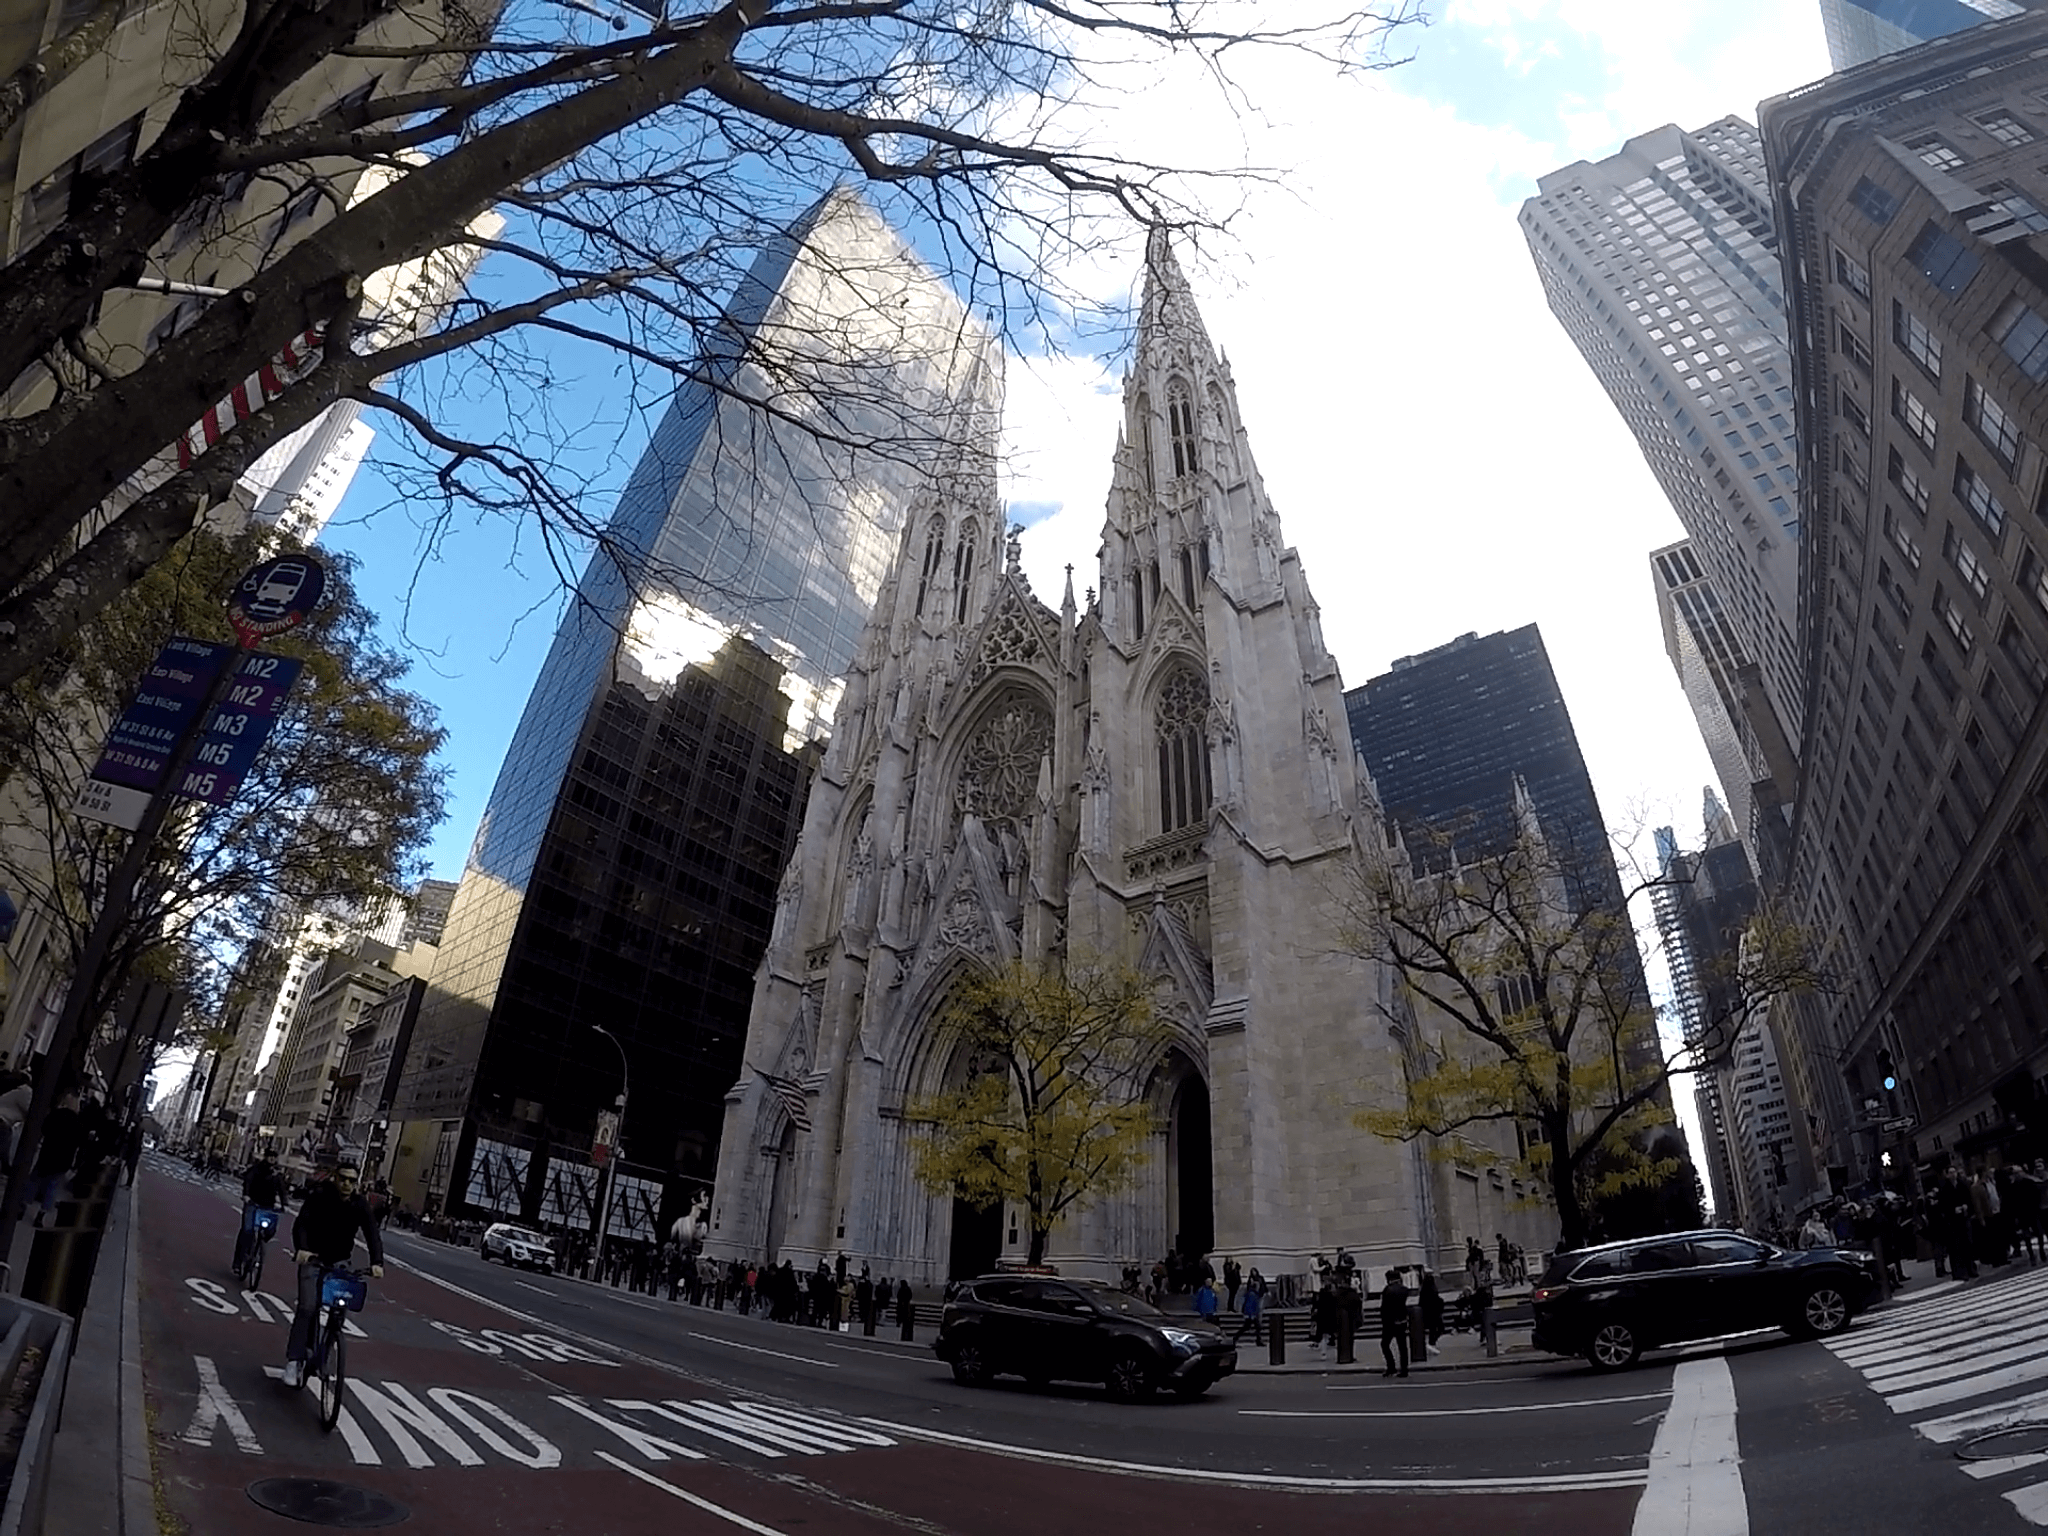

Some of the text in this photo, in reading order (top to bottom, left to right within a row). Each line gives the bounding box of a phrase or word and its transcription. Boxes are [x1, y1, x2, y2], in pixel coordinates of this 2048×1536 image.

[239, 615, 294, 633] STANDING
[244, 657, 280, 679] M2
[228, 684, 265, 707] M2
[213, 714, 248, 737] M3
[197, 742, 234, 766] M5
[182, 771, 218, 796] M5
[428, 1320, 623, 1367] BUS
[182, 1355, 562, 1468] ONLY
[548, 1394, 898, 1461] ONLY
